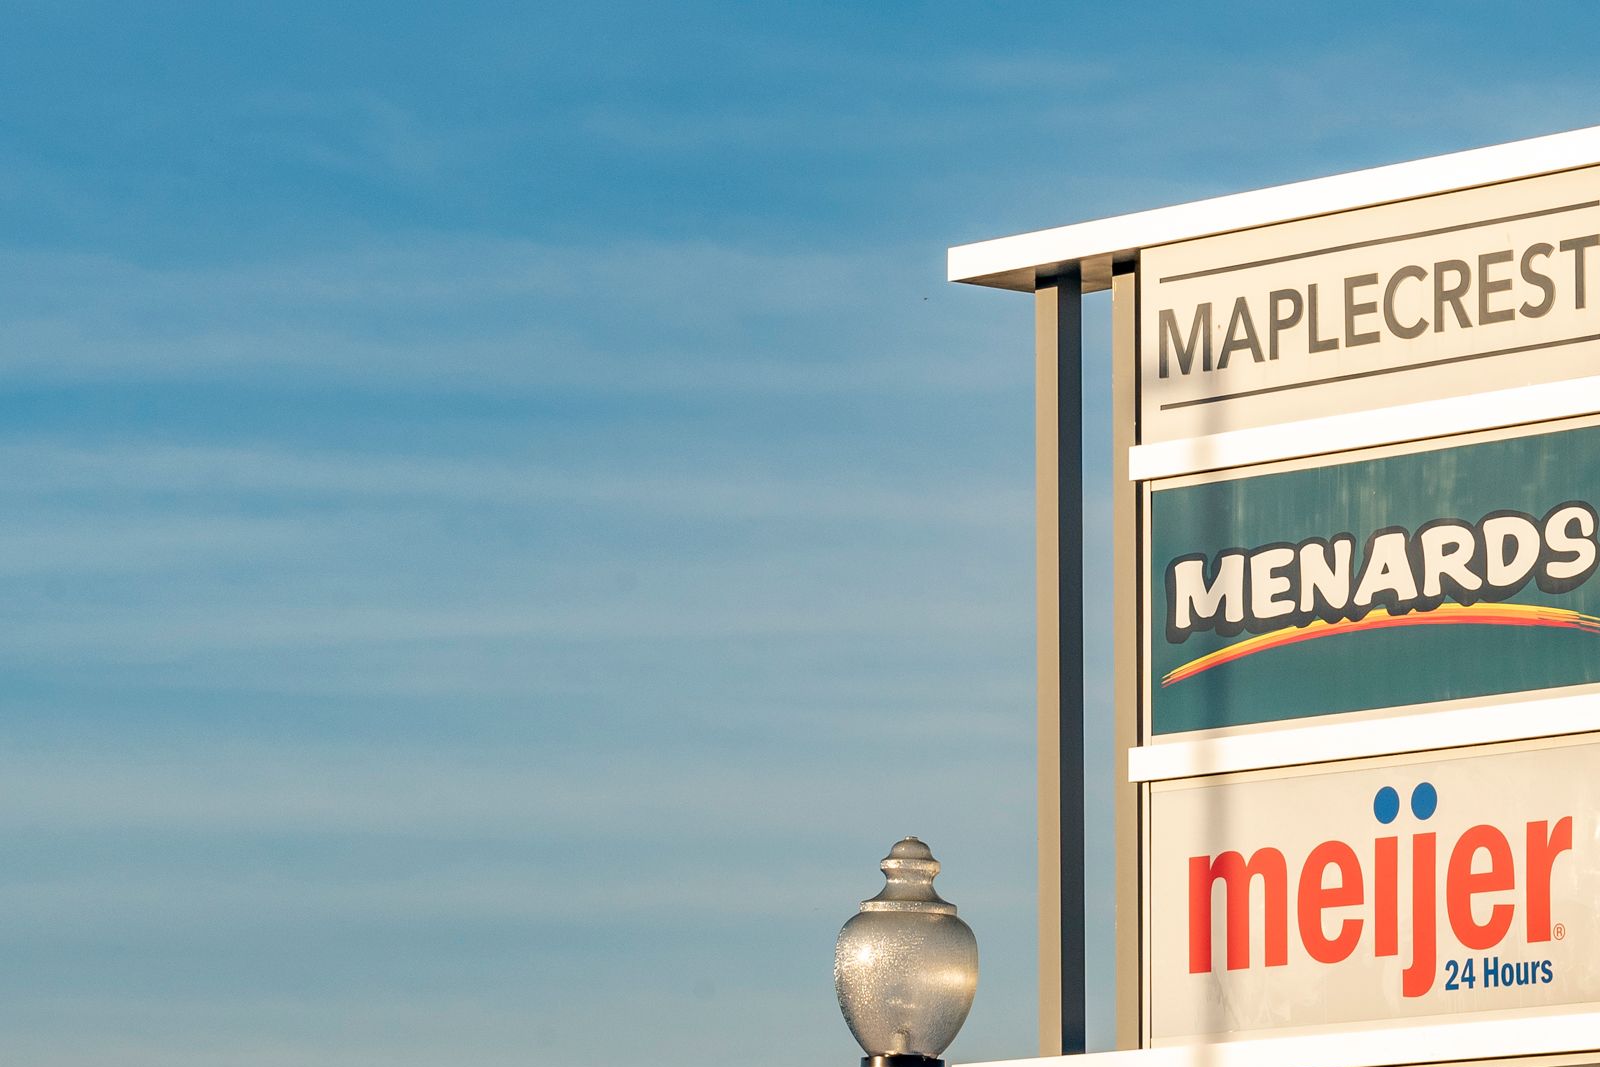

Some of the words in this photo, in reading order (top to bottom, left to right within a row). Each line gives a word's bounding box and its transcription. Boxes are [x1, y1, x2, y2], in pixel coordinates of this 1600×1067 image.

[1157, 233, 1600, 380] MAPLECREST
[1171, 504, 1599, 634] MENARDS
[1188, 781, 1573, 998] meijer
[1444, 959, 1476, 991] 24
[1483, 956, 1554, 989] Hours
